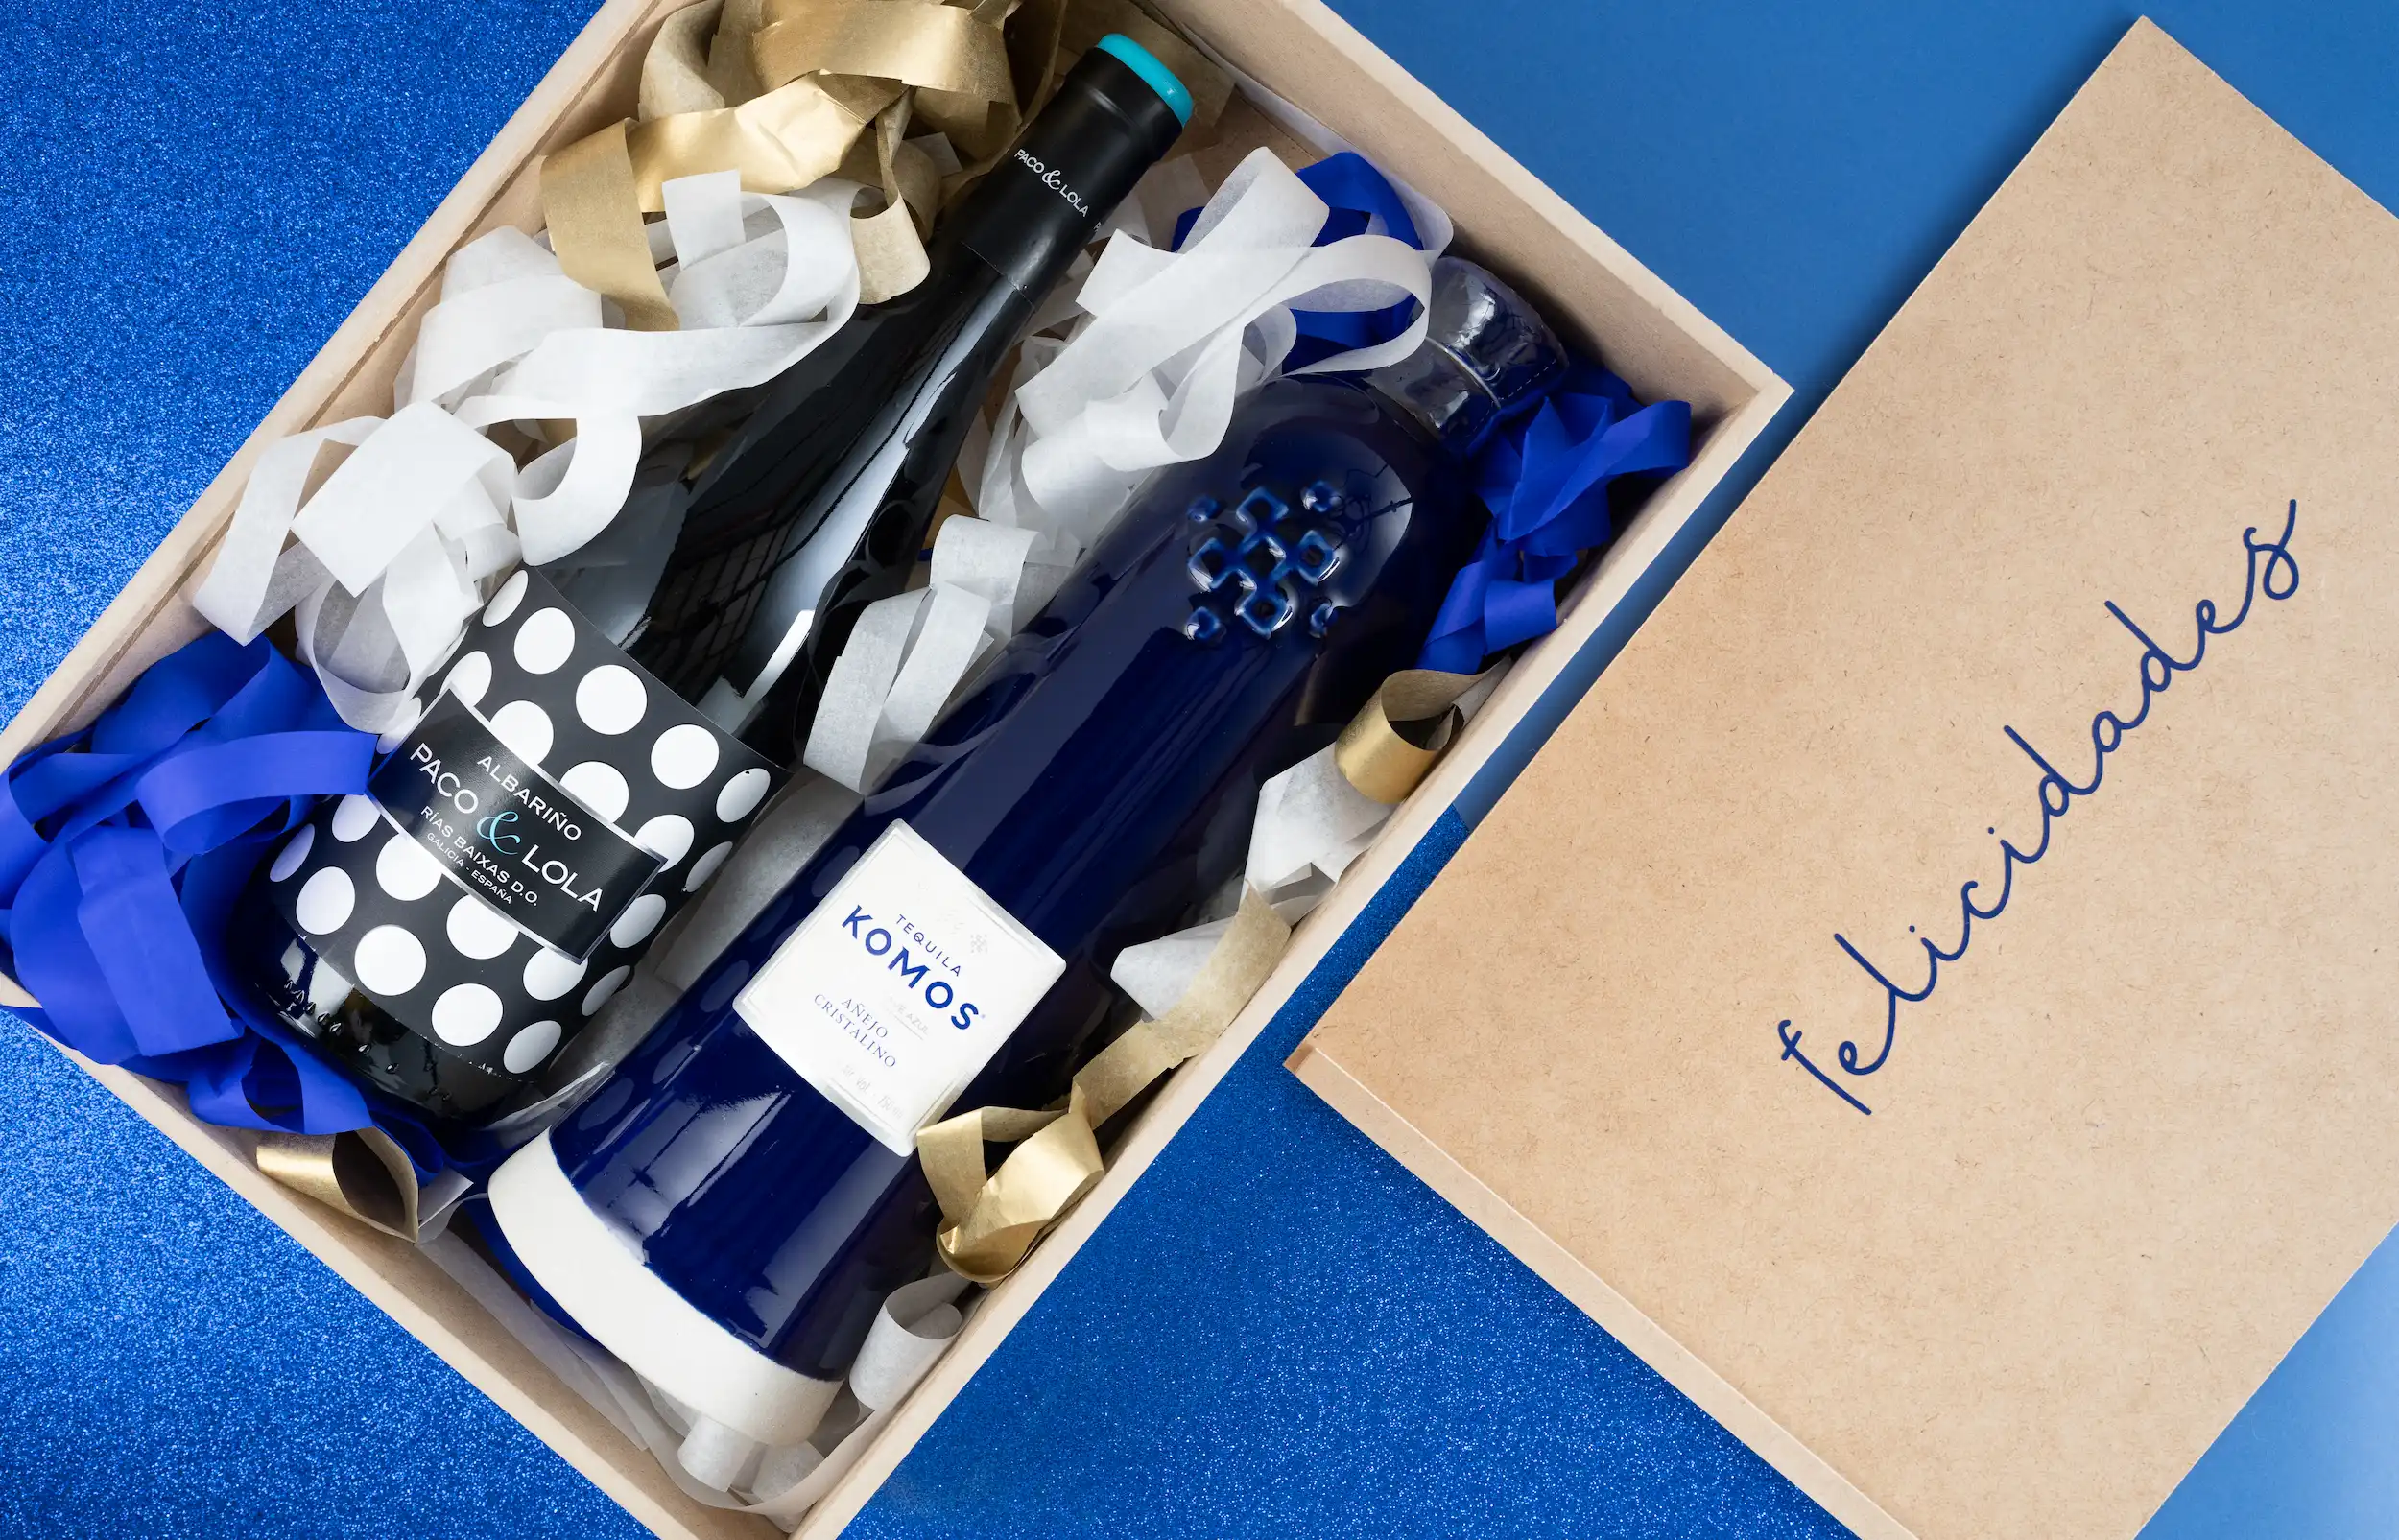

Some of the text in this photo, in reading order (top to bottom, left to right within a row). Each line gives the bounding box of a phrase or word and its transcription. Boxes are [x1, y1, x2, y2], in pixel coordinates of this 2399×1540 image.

[1013, 148, 1089, 217] PACO & LOLA
[410, 743, 604, 912] PACO & LOLA
[477, 755, 582, 841] ALBARIÑO
[1778, 498, 2299, 1115] felicidades
[420, 805, 538, 907] RÍAS BAIXAS D.O.
[427, 833, 464, 868] GALICIA
[470, 869, 512, 905] ESPAÑA
[842, 904, 979, 1030] KOMOS
[895, 913, 961, 977] TEQUILA
[814, 993, 896, 1068] CRISTALINO
[841, 997, 888, 1038] AÑEJO
